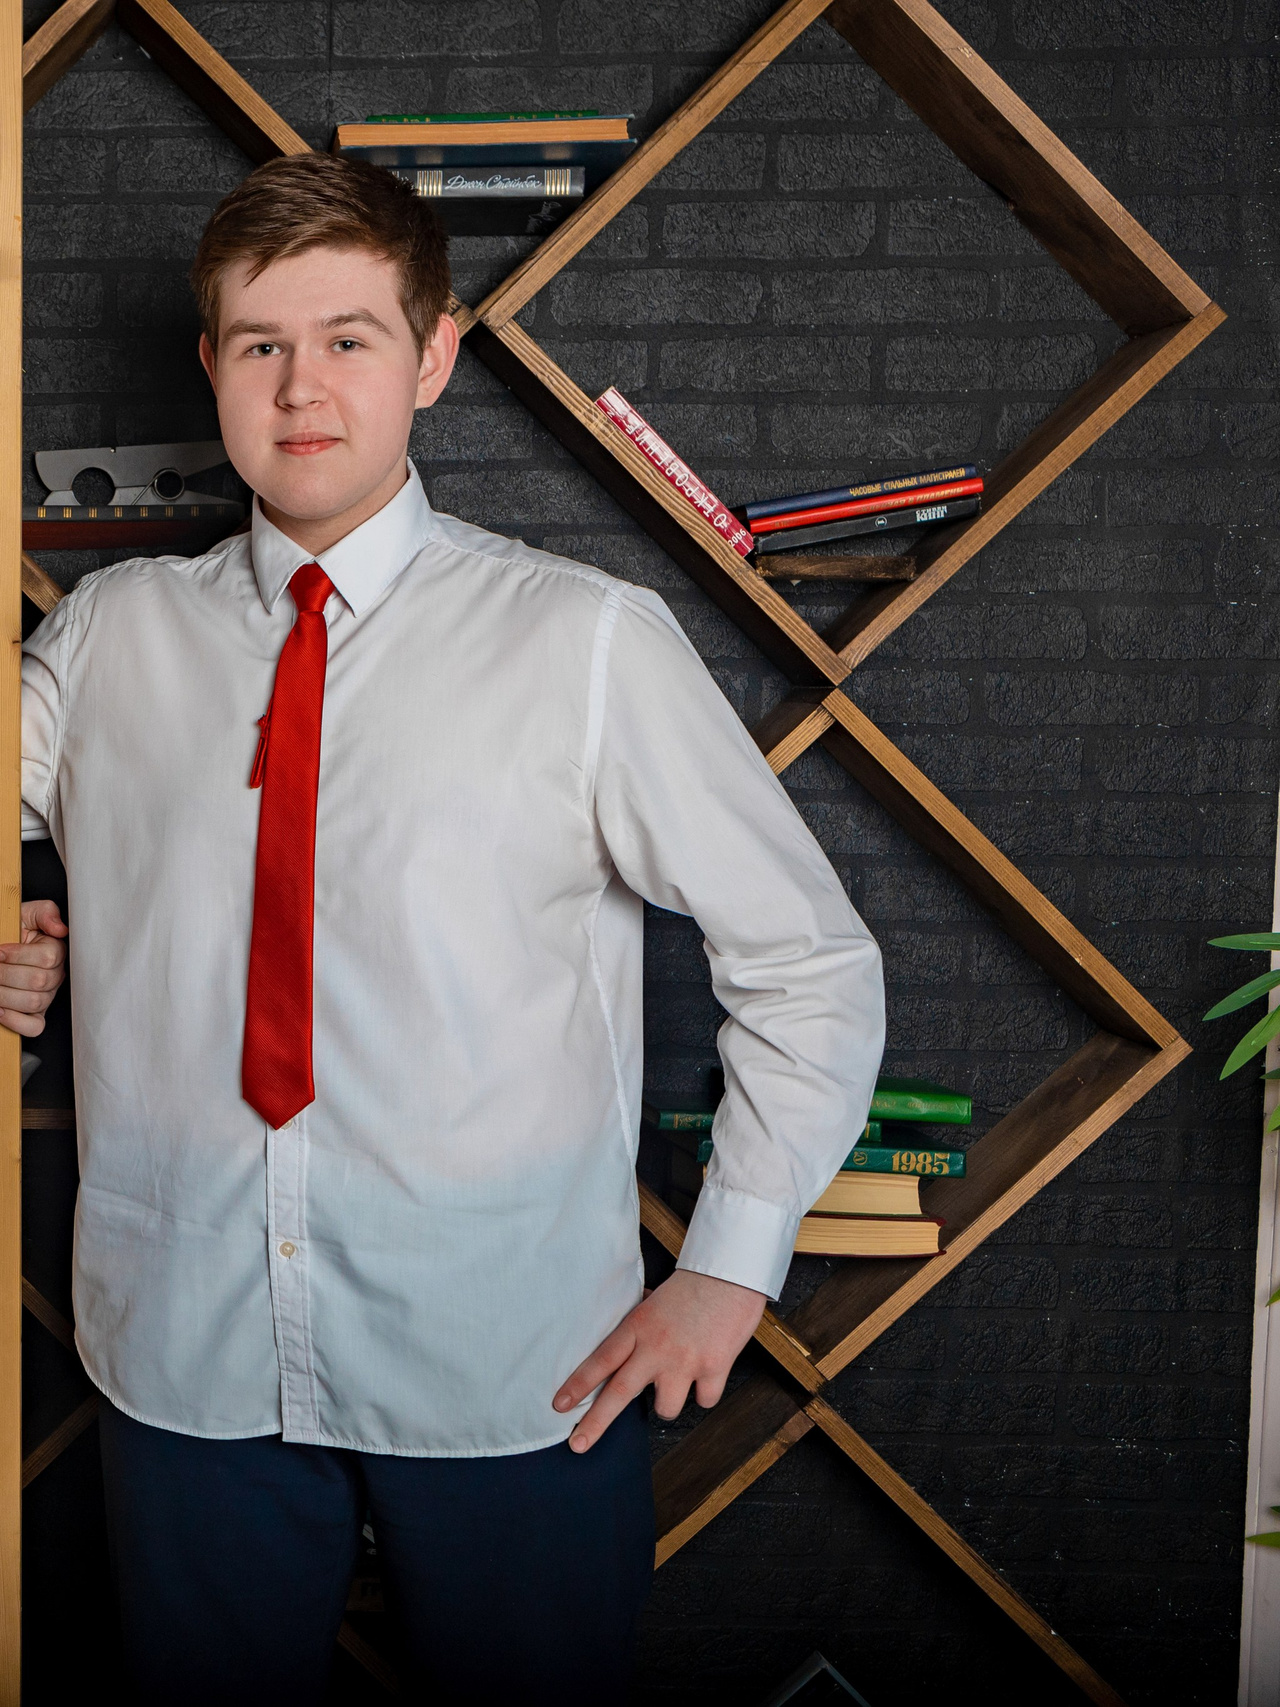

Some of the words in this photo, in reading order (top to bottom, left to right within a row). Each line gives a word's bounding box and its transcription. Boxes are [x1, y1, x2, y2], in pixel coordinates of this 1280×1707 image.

[625, 420, 730, 529] ОТКРОВЕНИЕ
[849, 483, 882, 497] ЧАСОВЫЕ
[883, 476, 918, 491] СТАЛЬНЫХ
[919, 467, 966, 485] МАГИСТРАЛЕЙ
[727, 527, 748, 548] 2006
[891, 1150, 950, 1175] 1985
